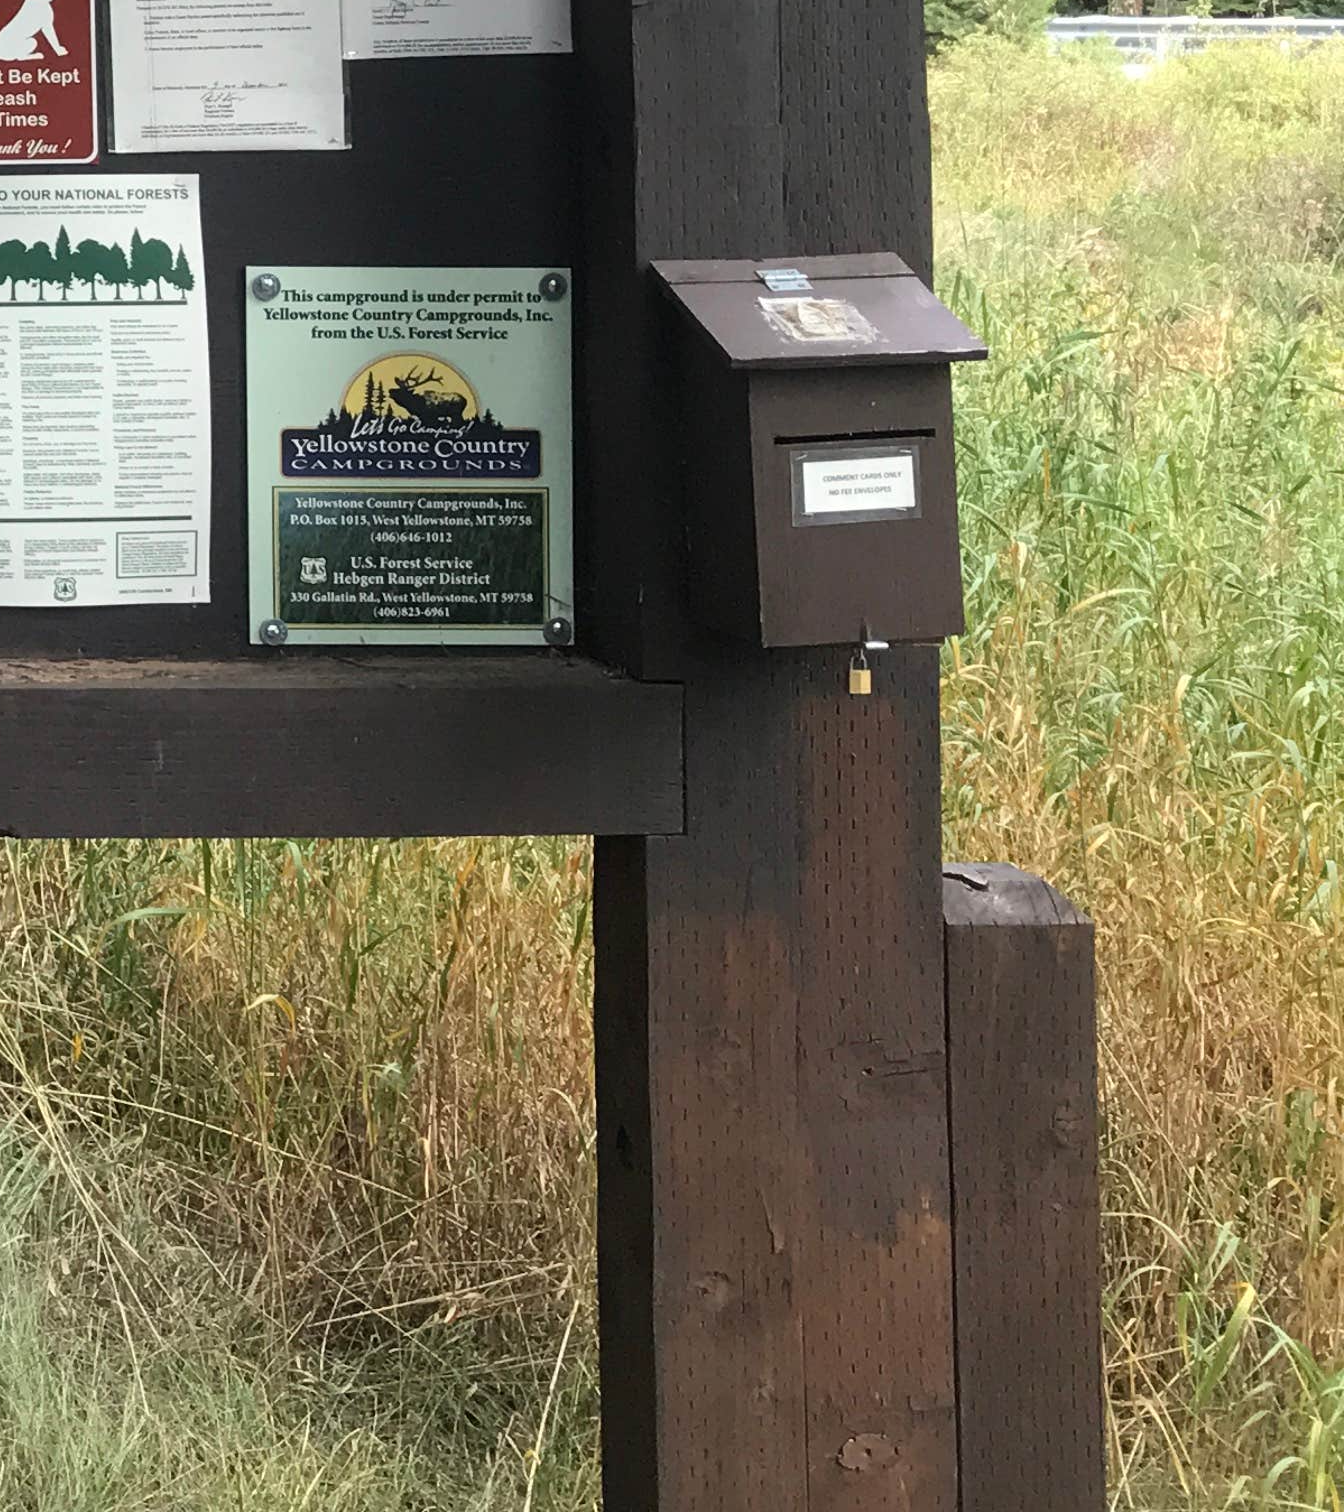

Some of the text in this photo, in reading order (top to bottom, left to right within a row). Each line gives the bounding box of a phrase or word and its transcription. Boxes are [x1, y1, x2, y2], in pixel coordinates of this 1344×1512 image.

[9, 69, 32, 83] Be
[38, 69, 80, 86] Kept
[12, 190, 51, 201] YOUR
[55, 189, 123, 200] NATIONAL
[127, 187, 189, 199] FORESTS
[281, 289, 542, 306] This campground is under permit to
[264, 308, 349, 320] Yellowstone
[352, 308, 413, 324] Country
[291, 436, 529, 458] Yellowstone Country
[291, 459, 521, 470] CAMPGROUNDS
[380, 557, 420, 568] Forest
[424, 557, 473, 569] Service
[334, 572, 490, 588] Hebgen Ranger District
